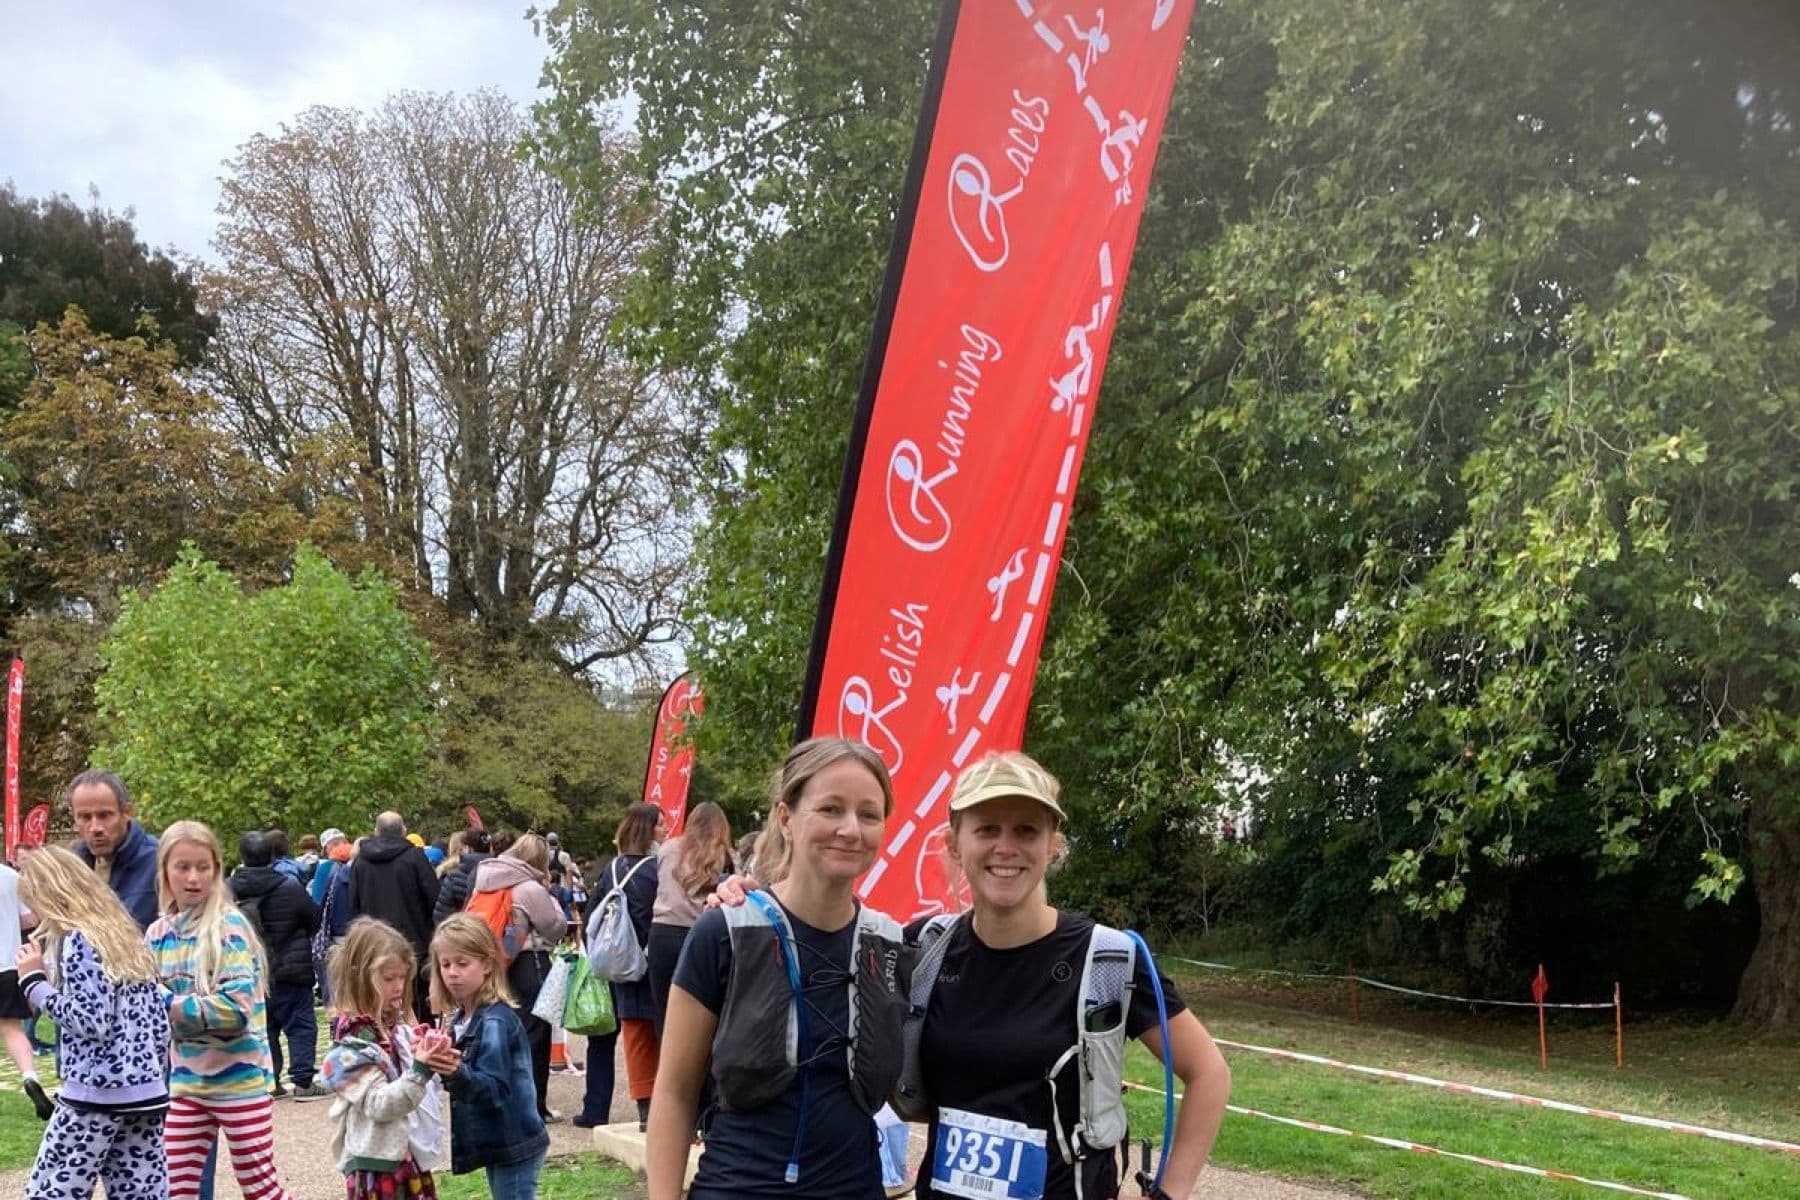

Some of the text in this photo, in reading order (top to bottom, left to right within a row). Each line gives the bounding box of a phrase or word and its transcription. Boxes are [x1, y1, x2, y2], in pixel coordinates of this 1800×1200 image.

[838, 89, 1050, 777] Relish Running Races
[651, 747, 669, 807] STA
[945, 1127, 1024, 1183] 9351
